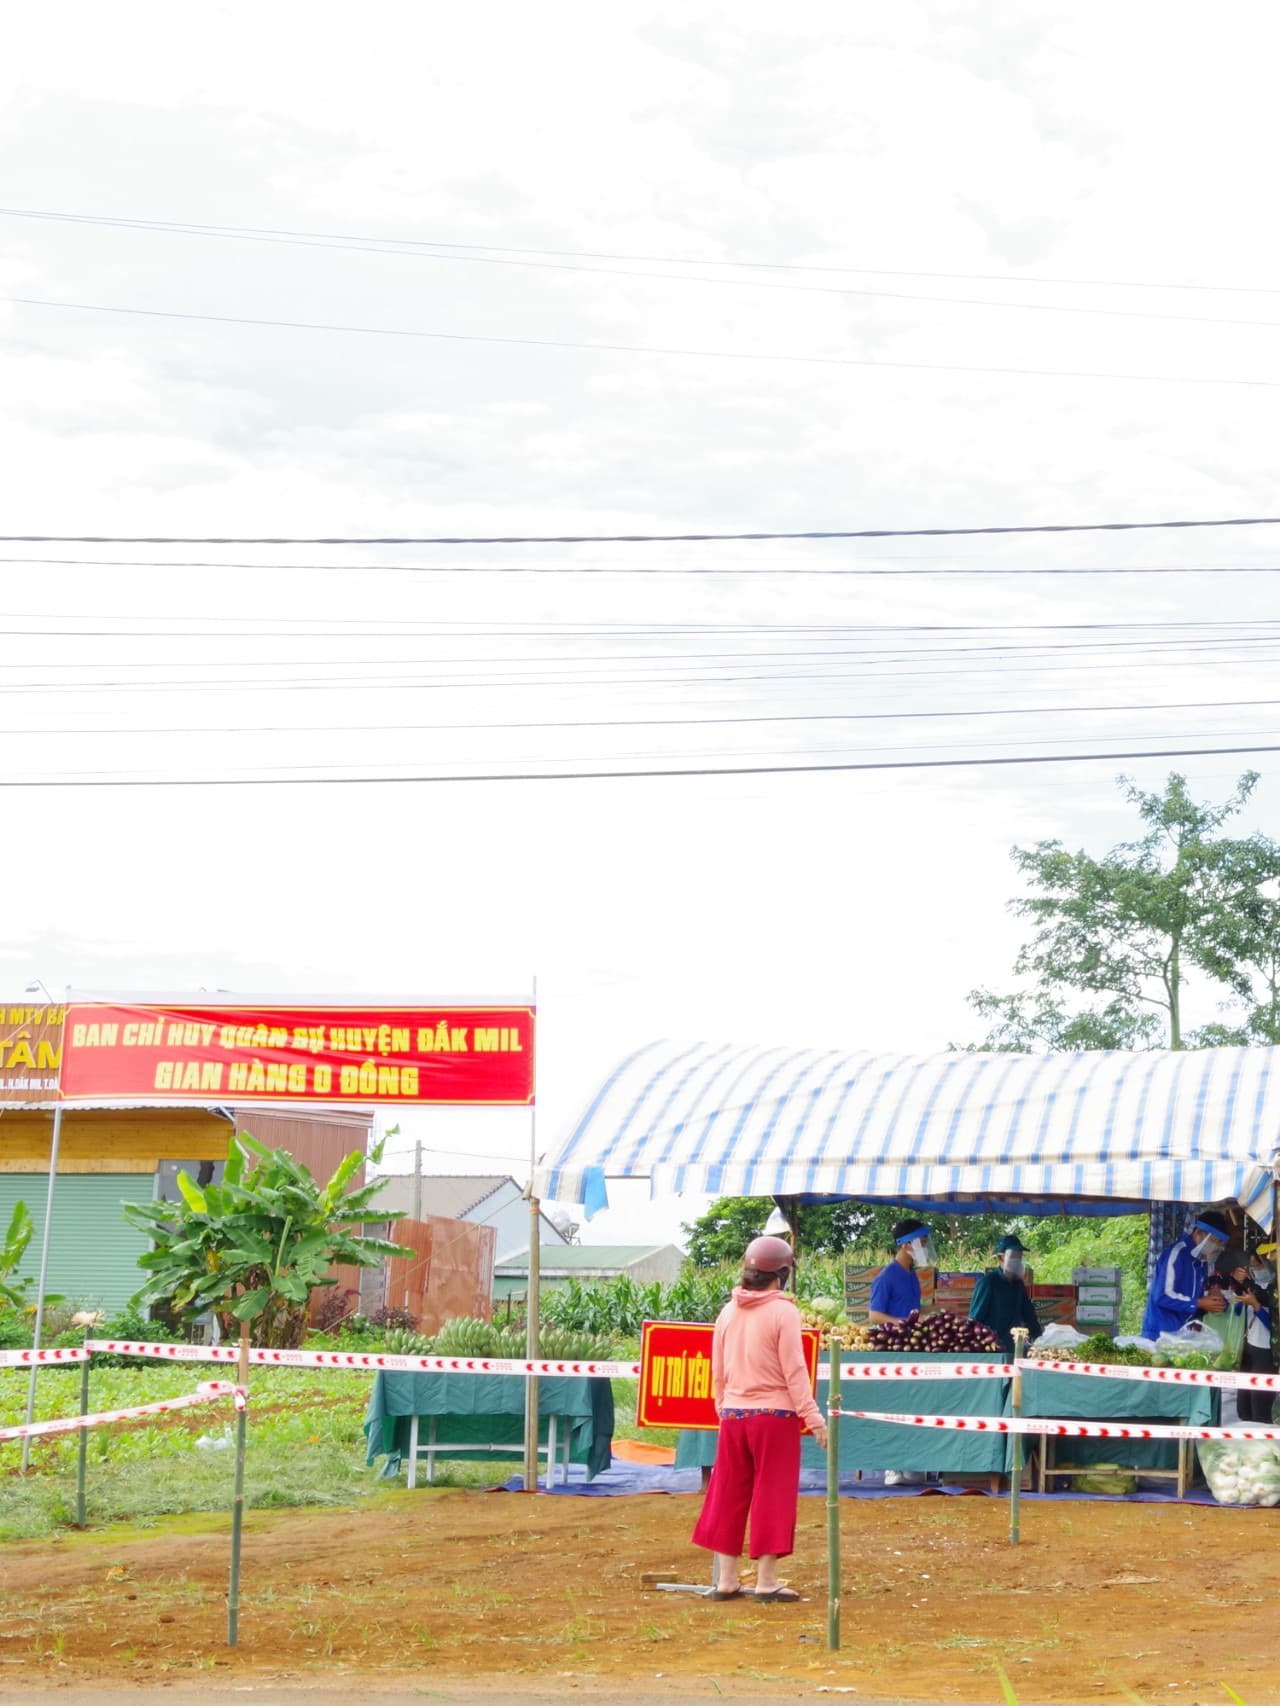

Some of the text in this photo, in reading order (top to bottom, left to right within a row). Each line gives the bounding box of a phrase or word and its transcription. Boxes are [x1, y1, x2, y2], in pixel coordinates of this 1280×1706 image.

[72, 1016, 523, 1056] BAN CHỈ HUY QUÂN SỰ HUYỆN ĐẮK MIL
[154, 1061, 223, 1090] GIAN
[228, 1058, 307, 1093] HÀNG
[651, 1355, 666, 1407] VỊ
[666, 1349, 687, 1399] TRÍ
[687, 1350, 711, 1399] YÊU
